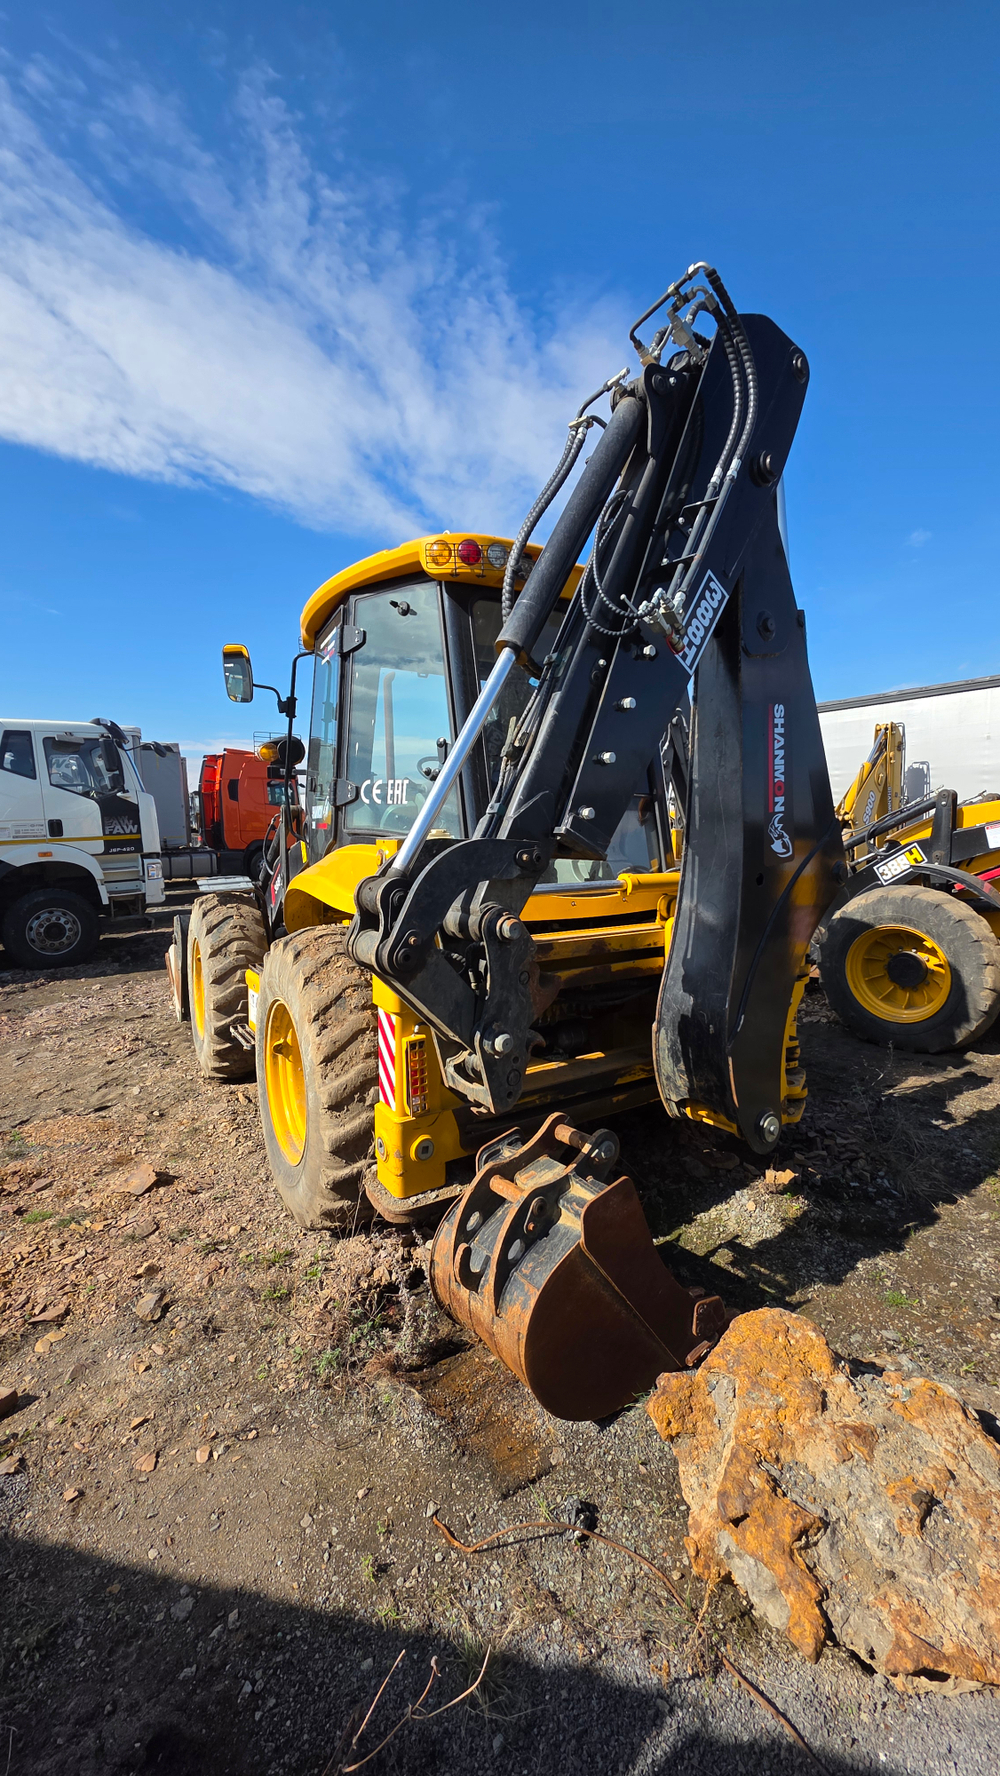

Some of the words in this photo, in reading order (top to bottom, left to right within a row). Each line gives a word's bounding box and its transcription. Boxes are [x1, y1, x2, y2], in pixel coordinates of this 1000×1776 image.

[774, 703, 785, 812] SHANMON
[360, 779, 383, 805] CE
[387, 779, 409, 805] EAC
[863, 791, 876, 825] S900
[104, 824, 138, 835] FAW
[878, 847, 924, 880] 388H
